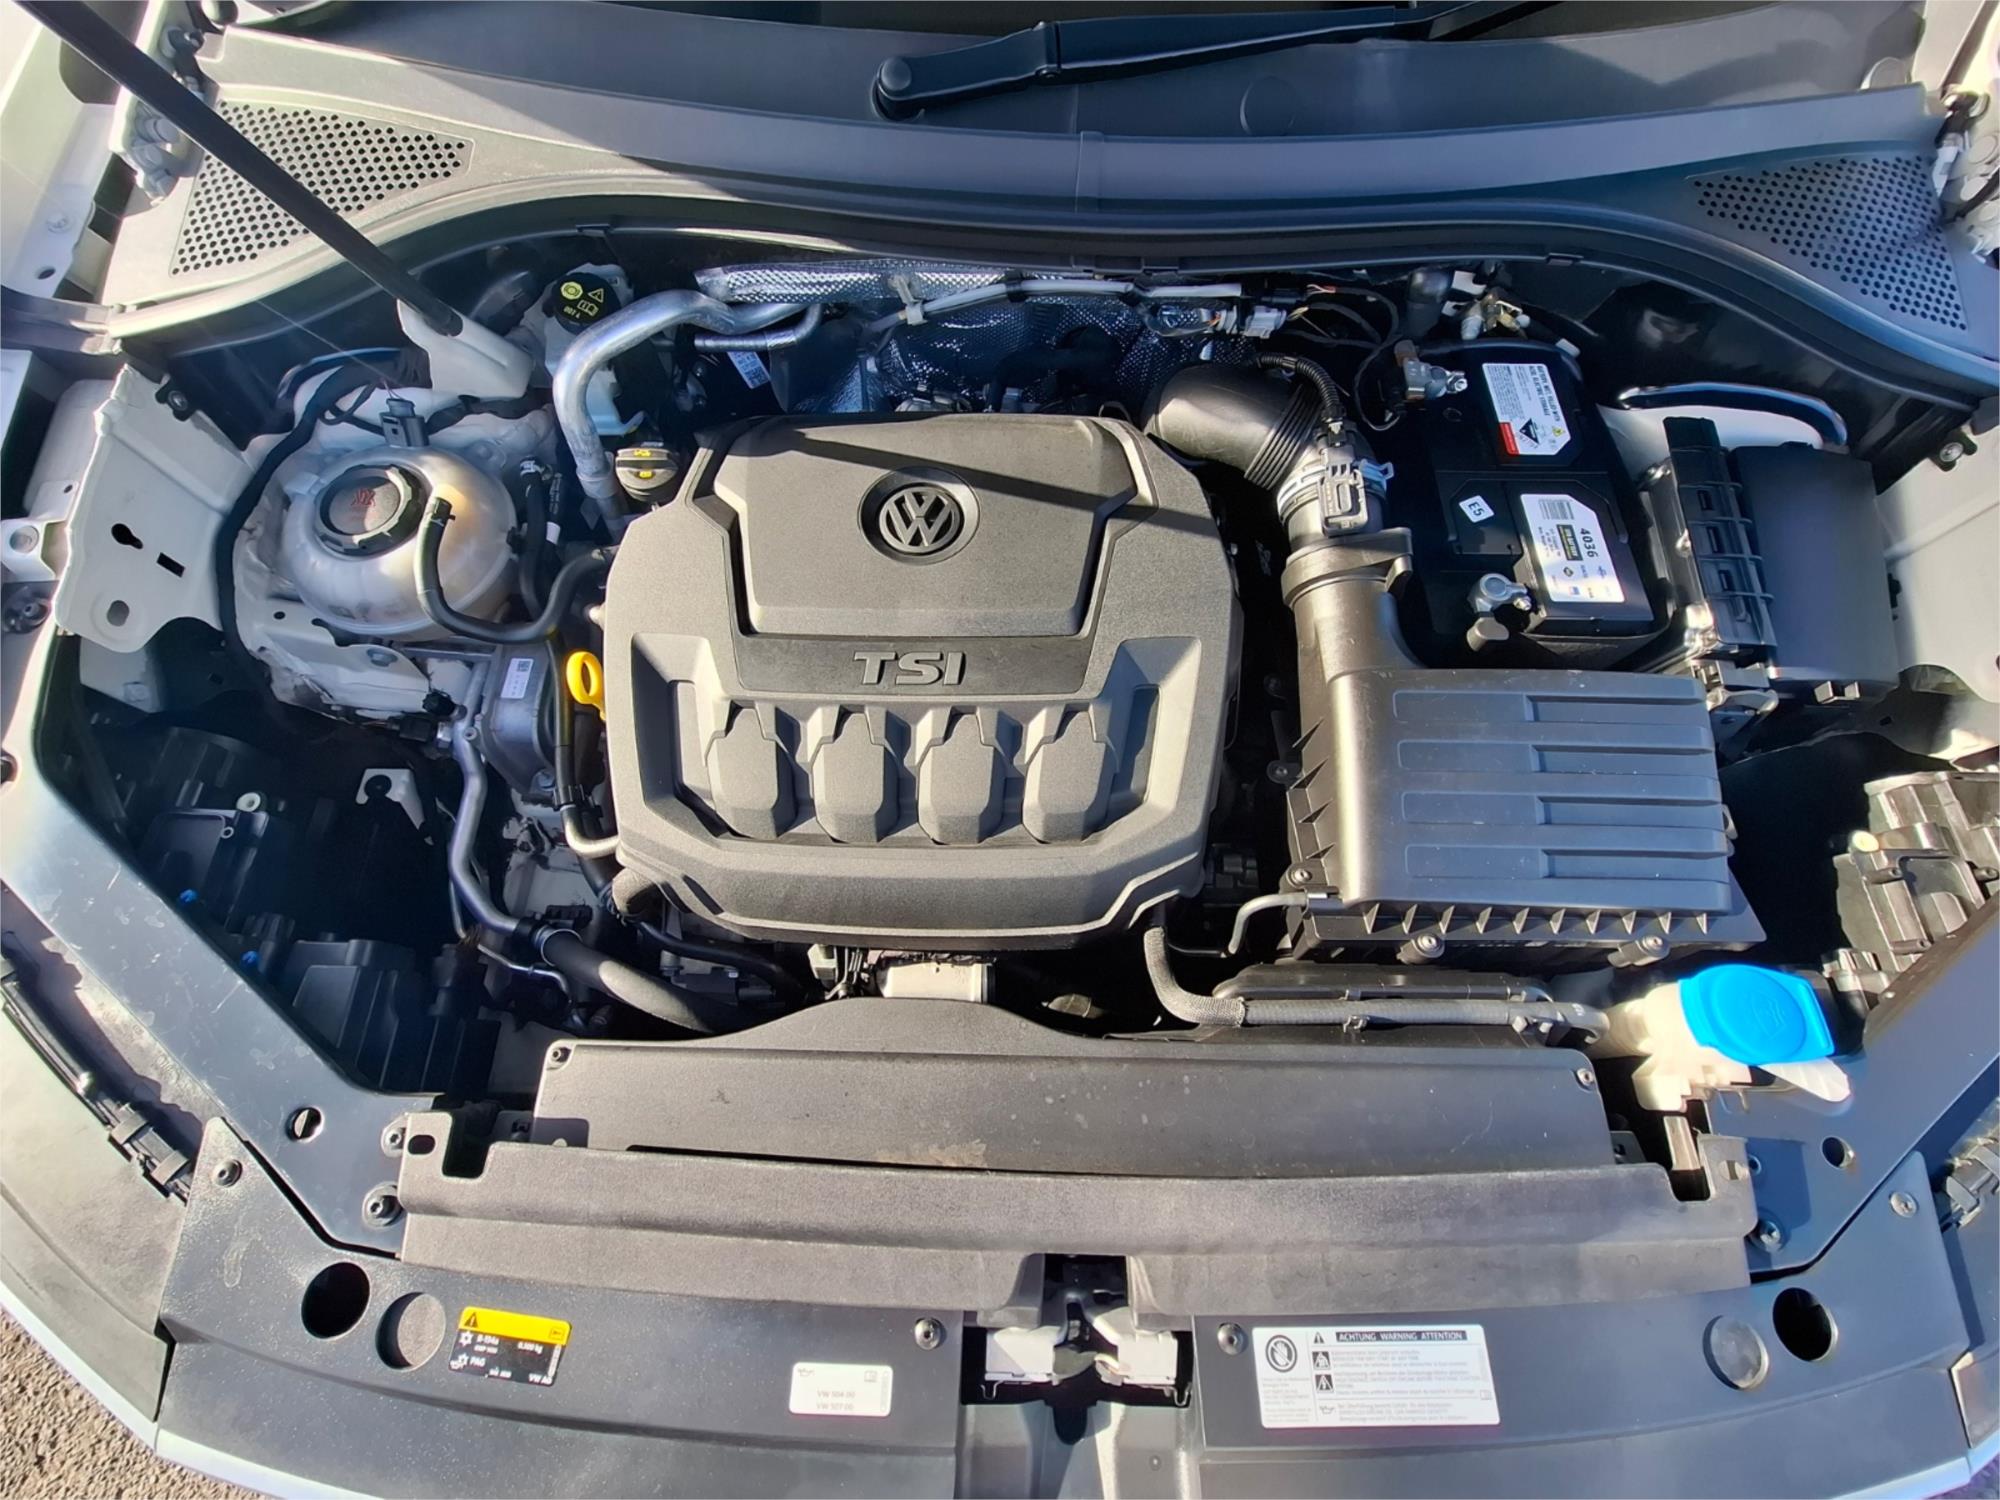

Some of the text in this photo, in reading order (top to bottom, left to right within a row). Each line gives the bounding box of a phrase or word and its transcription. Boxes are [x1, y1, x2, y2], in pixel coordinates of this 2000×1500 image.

[1468, 501, 1485, 517] E5
[1579, 527, 1599, 559] 4036
[854, 651, 965, 686] TSI
[1338, 1330, 1463, 1342] ACHTUNG WARNING ATTENTION
[528, 1373, 540, 1384] VW
